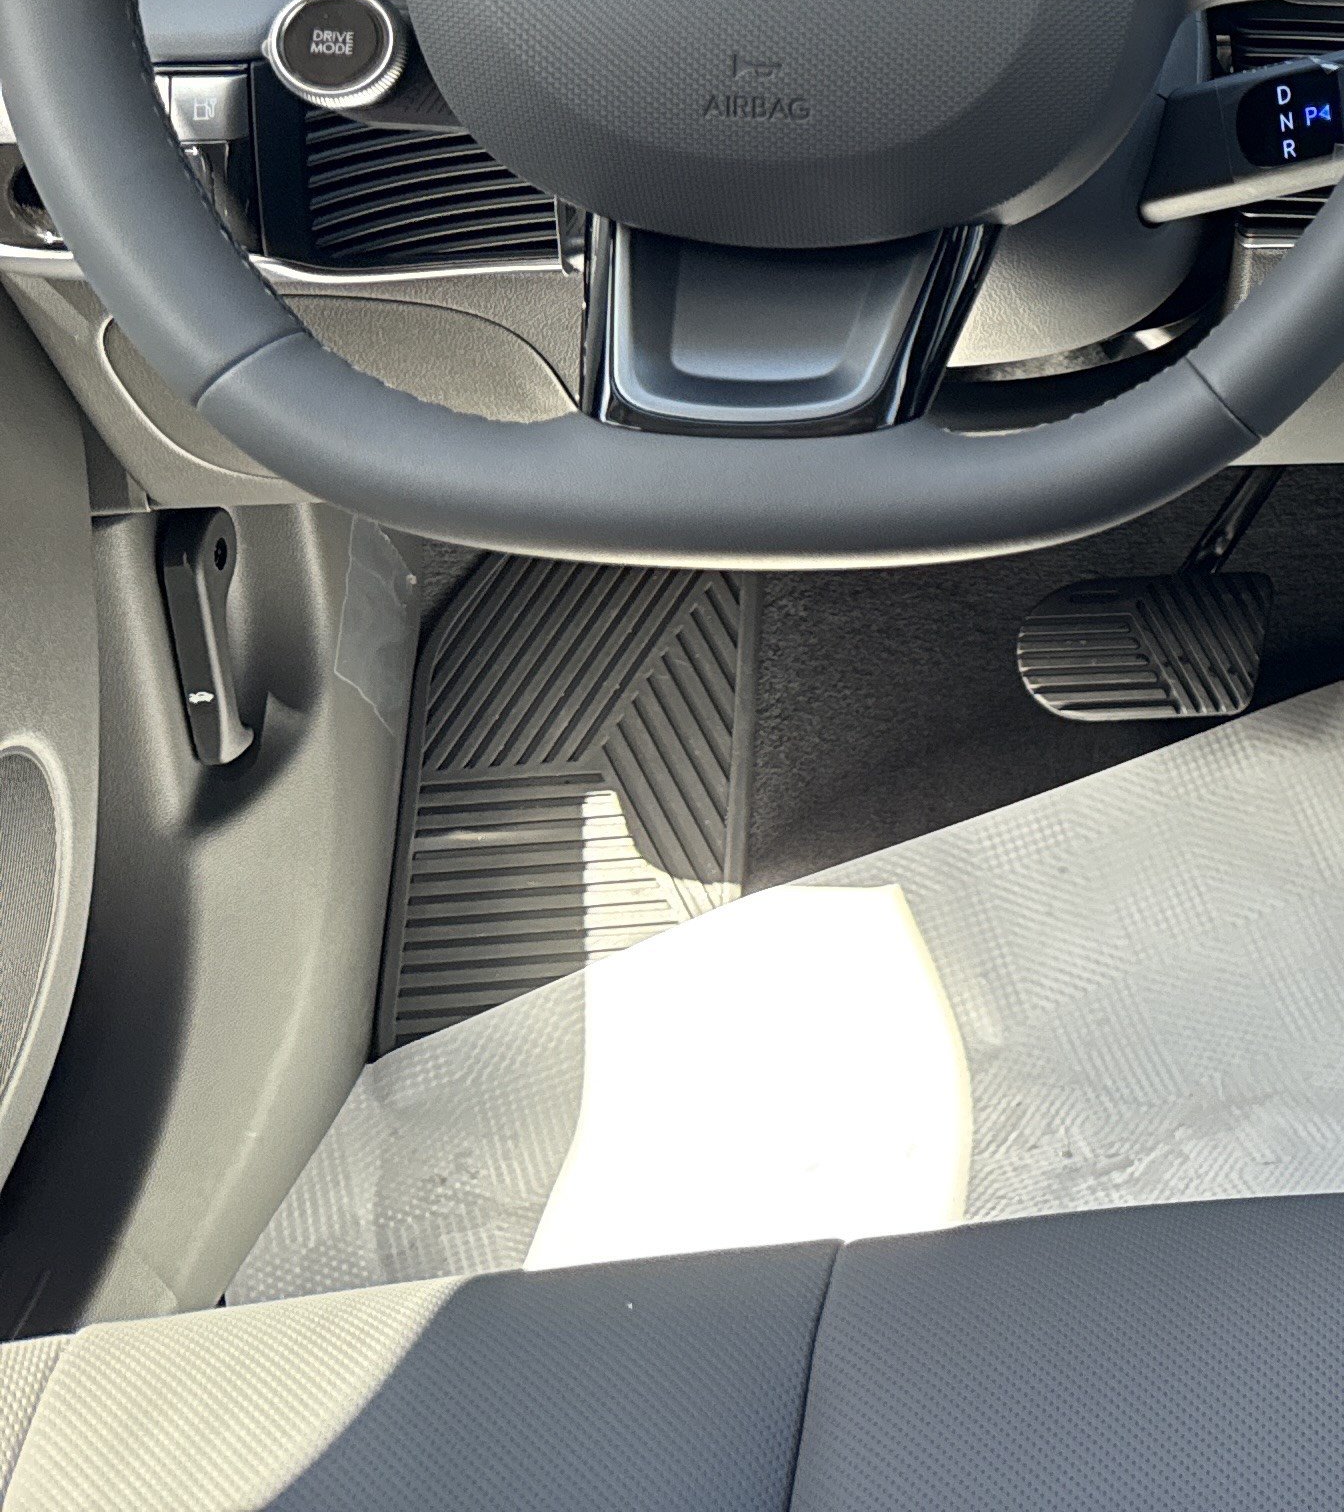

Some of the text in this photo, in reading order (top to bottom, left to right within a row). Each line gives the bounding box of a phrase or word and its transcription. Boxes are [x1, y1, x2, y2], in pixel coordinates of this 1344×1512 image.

[312, 29, 354, 43] DRIVE
[310, 41, 353, 55] MODE
[1277, 85, 1291, 105] D
[703, 94, 810, 120] AIRBAG
[1305, 106, 1317, 124] P
[1280, 113, 1294, 131] N
[1283, 140, 1296, 158] R
